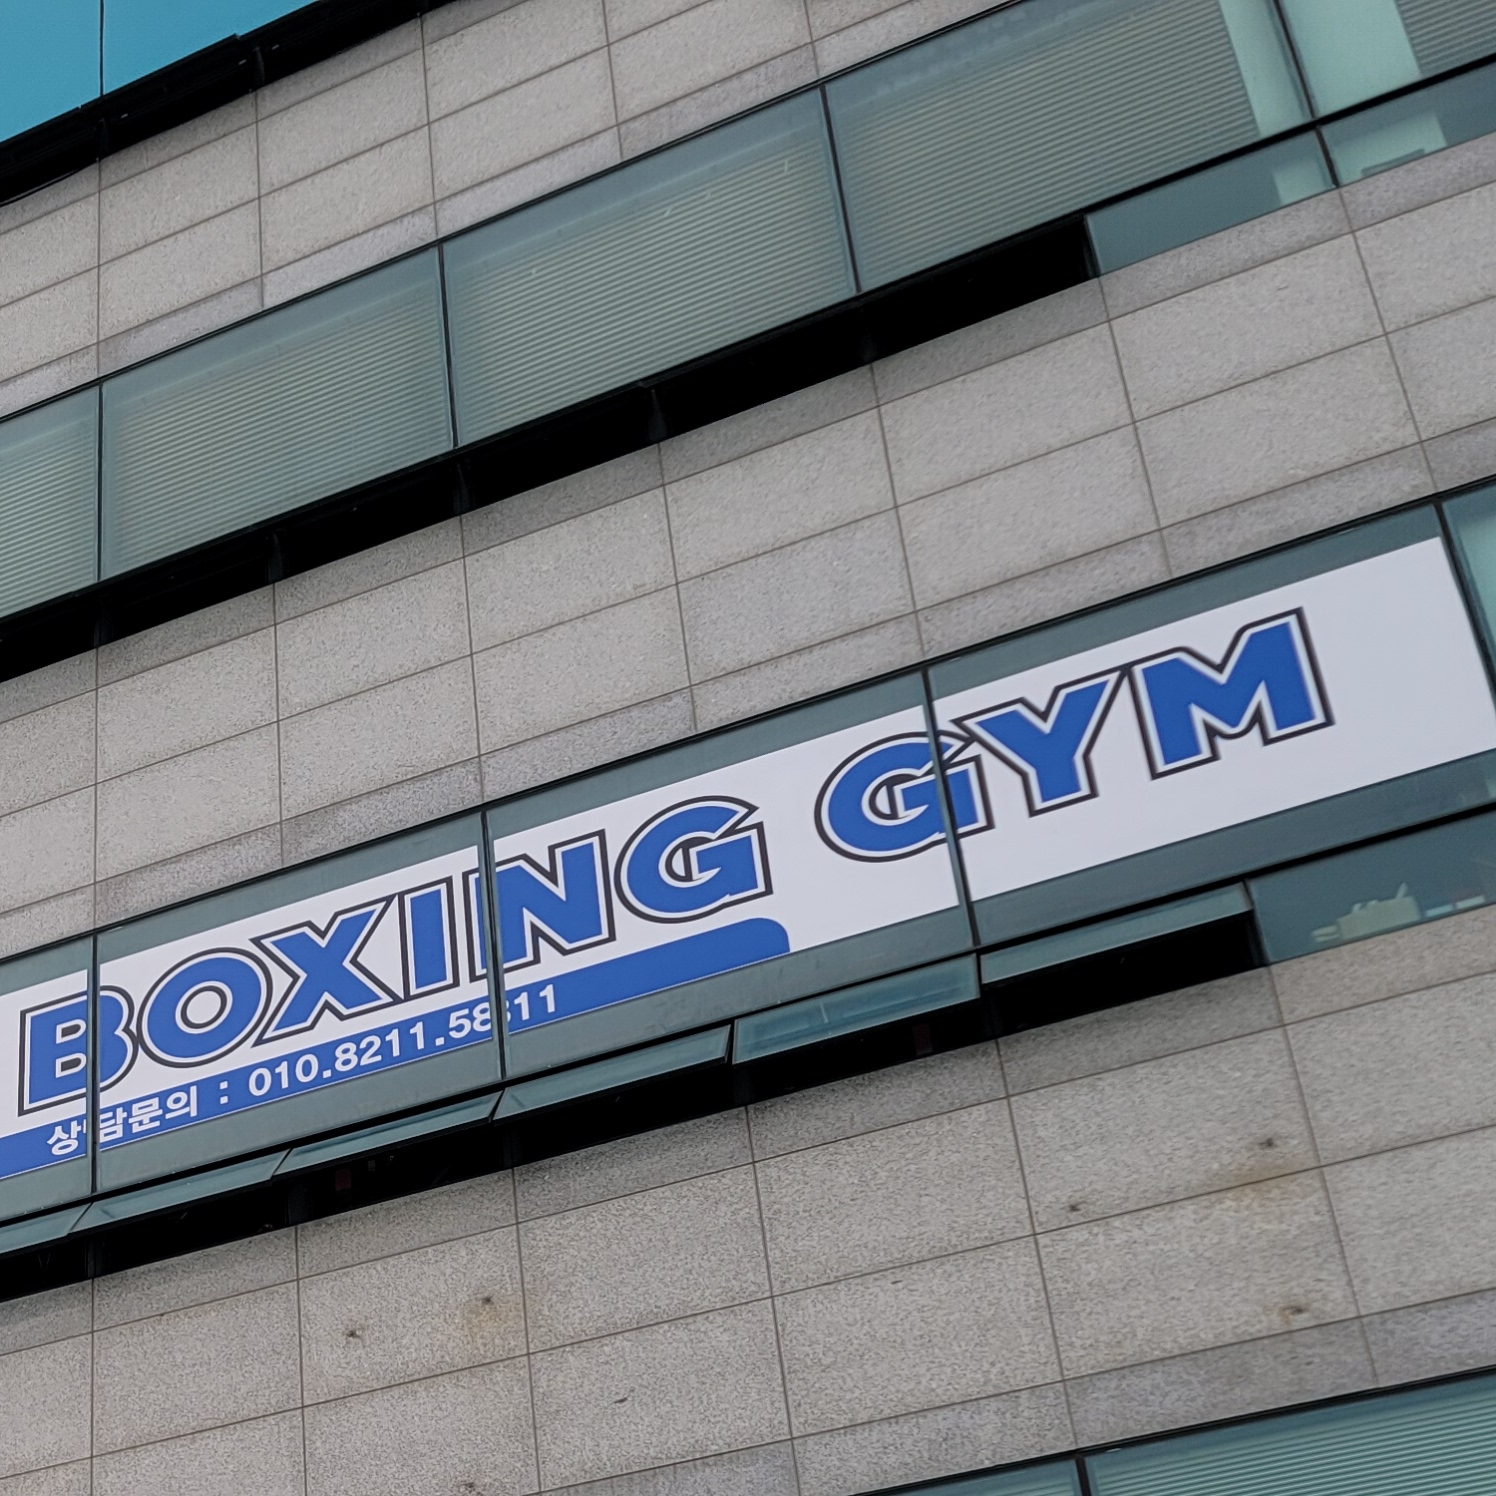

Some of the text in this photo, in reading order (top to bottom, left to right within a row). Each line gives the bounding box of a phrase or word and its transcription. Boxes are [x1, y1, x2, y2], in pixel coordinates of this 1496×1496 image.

[18, 795, 773, 1117] BOXING
[814, 606, 1335, 863] GYM
[47, 1085, 197, 1155] 상담문의
[248, 983, 555, 1098] 010.8211.5811
